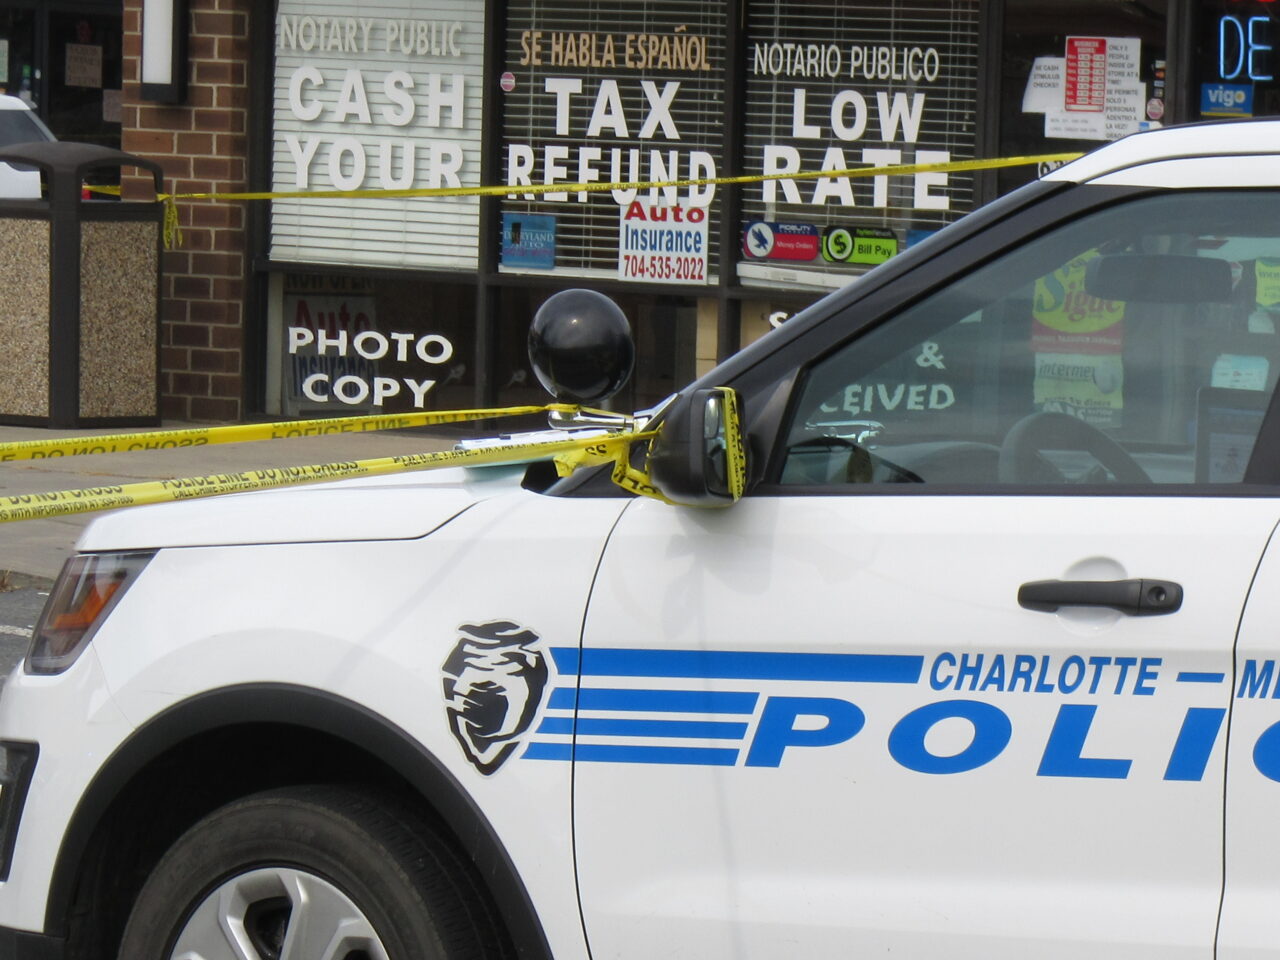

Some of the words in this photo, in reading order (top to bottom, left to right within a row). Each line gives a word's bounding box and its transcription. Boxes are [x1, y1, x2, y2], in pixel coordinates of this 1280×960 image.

[279, 15, 374, 54] NOTARY
[385, 18, 463, 57] PUBLIC
[520, 31, 542, 66] SE
[551, 33, 616, 68] HABLA
[625, 25, 711, 71] ESPAÑOL
[1219, 15, 1274, 80] DE
[754, 42, 841, 77] NOTARIO
[850, 46, 940, 82] PUBLICO
[288, 66, 466, 128] CASH
[545, 78, 681, 140] TAX
[792, 88, 926, 143] LOW
[1207, 86, 1246, 108] vigo
[285, 134, 465, 191] YOUR
[507, 144, 717, 207] REFUND
[762, 144, 950, 209] RATE
[624, 200, 705, 223] Auto
[504, 231, 554, 243] DRYLAND
[625, 224, 702, 253] Insurance
[857, 243, 872, 254] Bill
[874, 245, 893, 257] Pay
[624, 255, 704, 281] 704-535-2022
[288, 326, 453, 364] PHOTO
[916, 341, 946, 370] &
[302, 373, 437, 408] COPY
[929, 652, 1162, 697] CHARLOTTE
